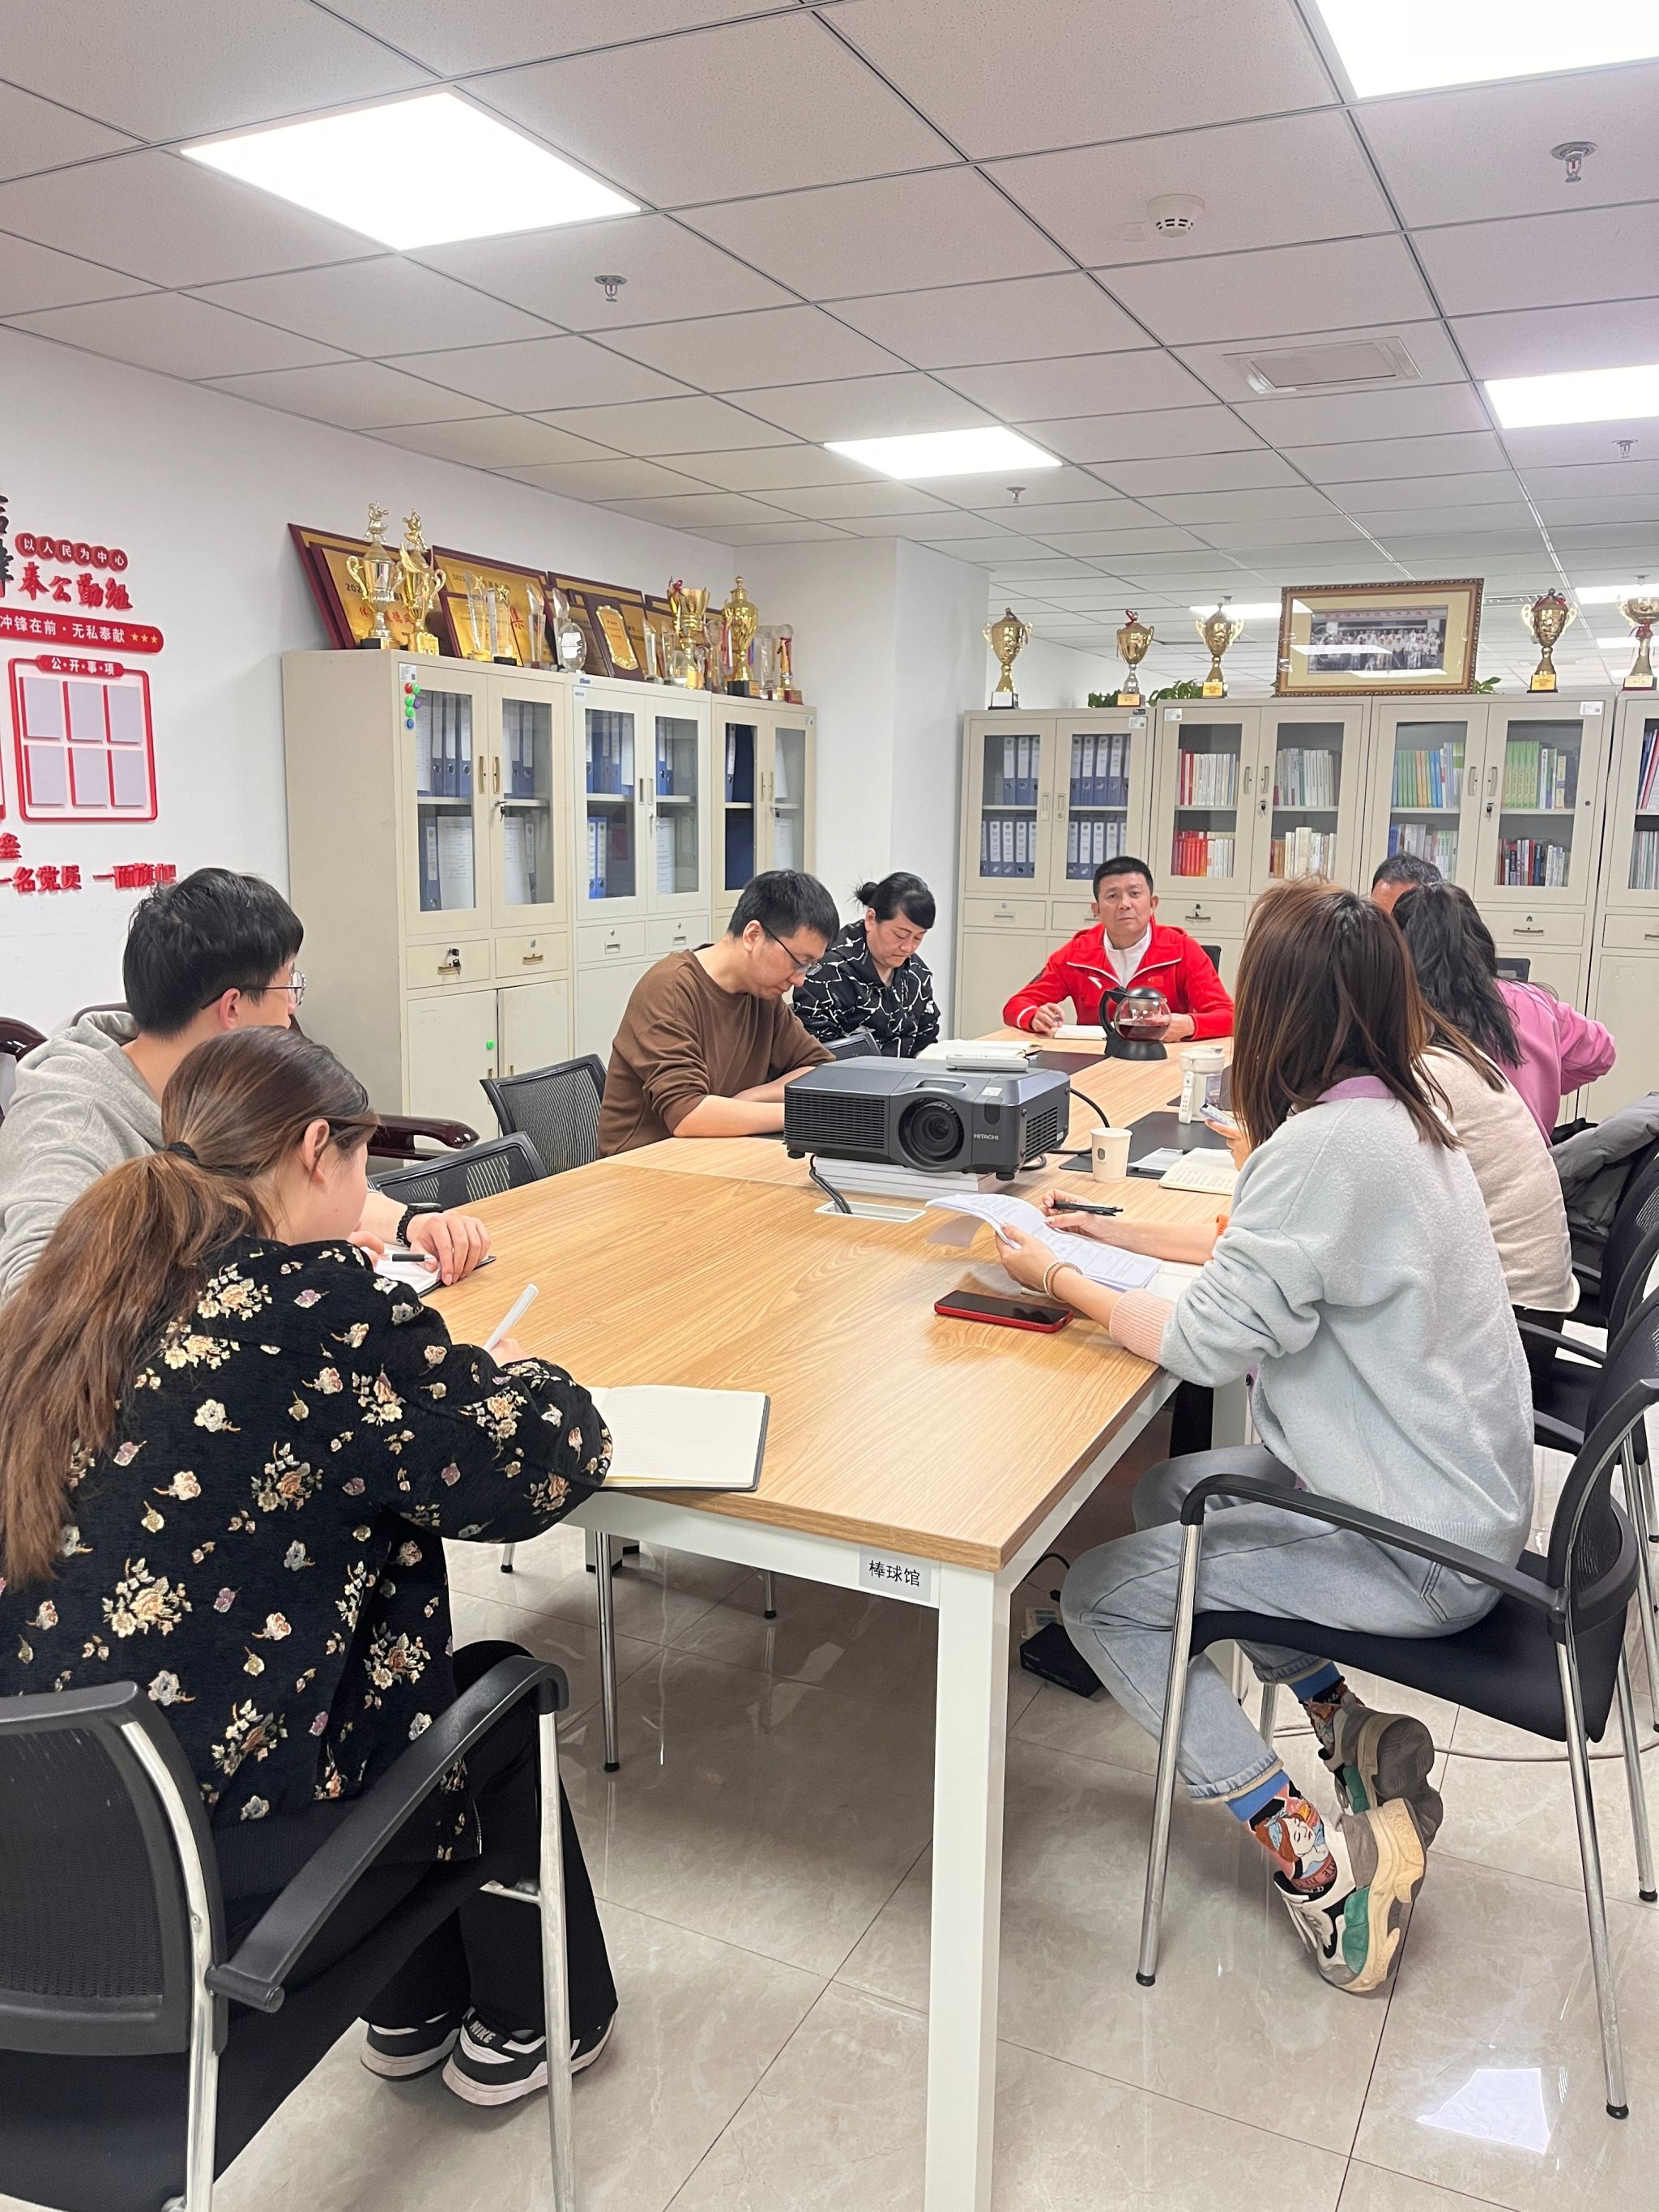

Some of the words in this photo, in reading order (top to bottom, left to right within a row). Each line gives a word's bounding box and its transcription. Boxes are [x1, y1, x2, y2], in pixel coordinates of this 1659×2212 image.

[23, 537, 125, 566] 以人民为中心
[973, 1133, 1000, 1141] HITACHI
[868, 1559, 920, 1587] 棒球馆
[469, 2020, 497, 2043] NIKE
